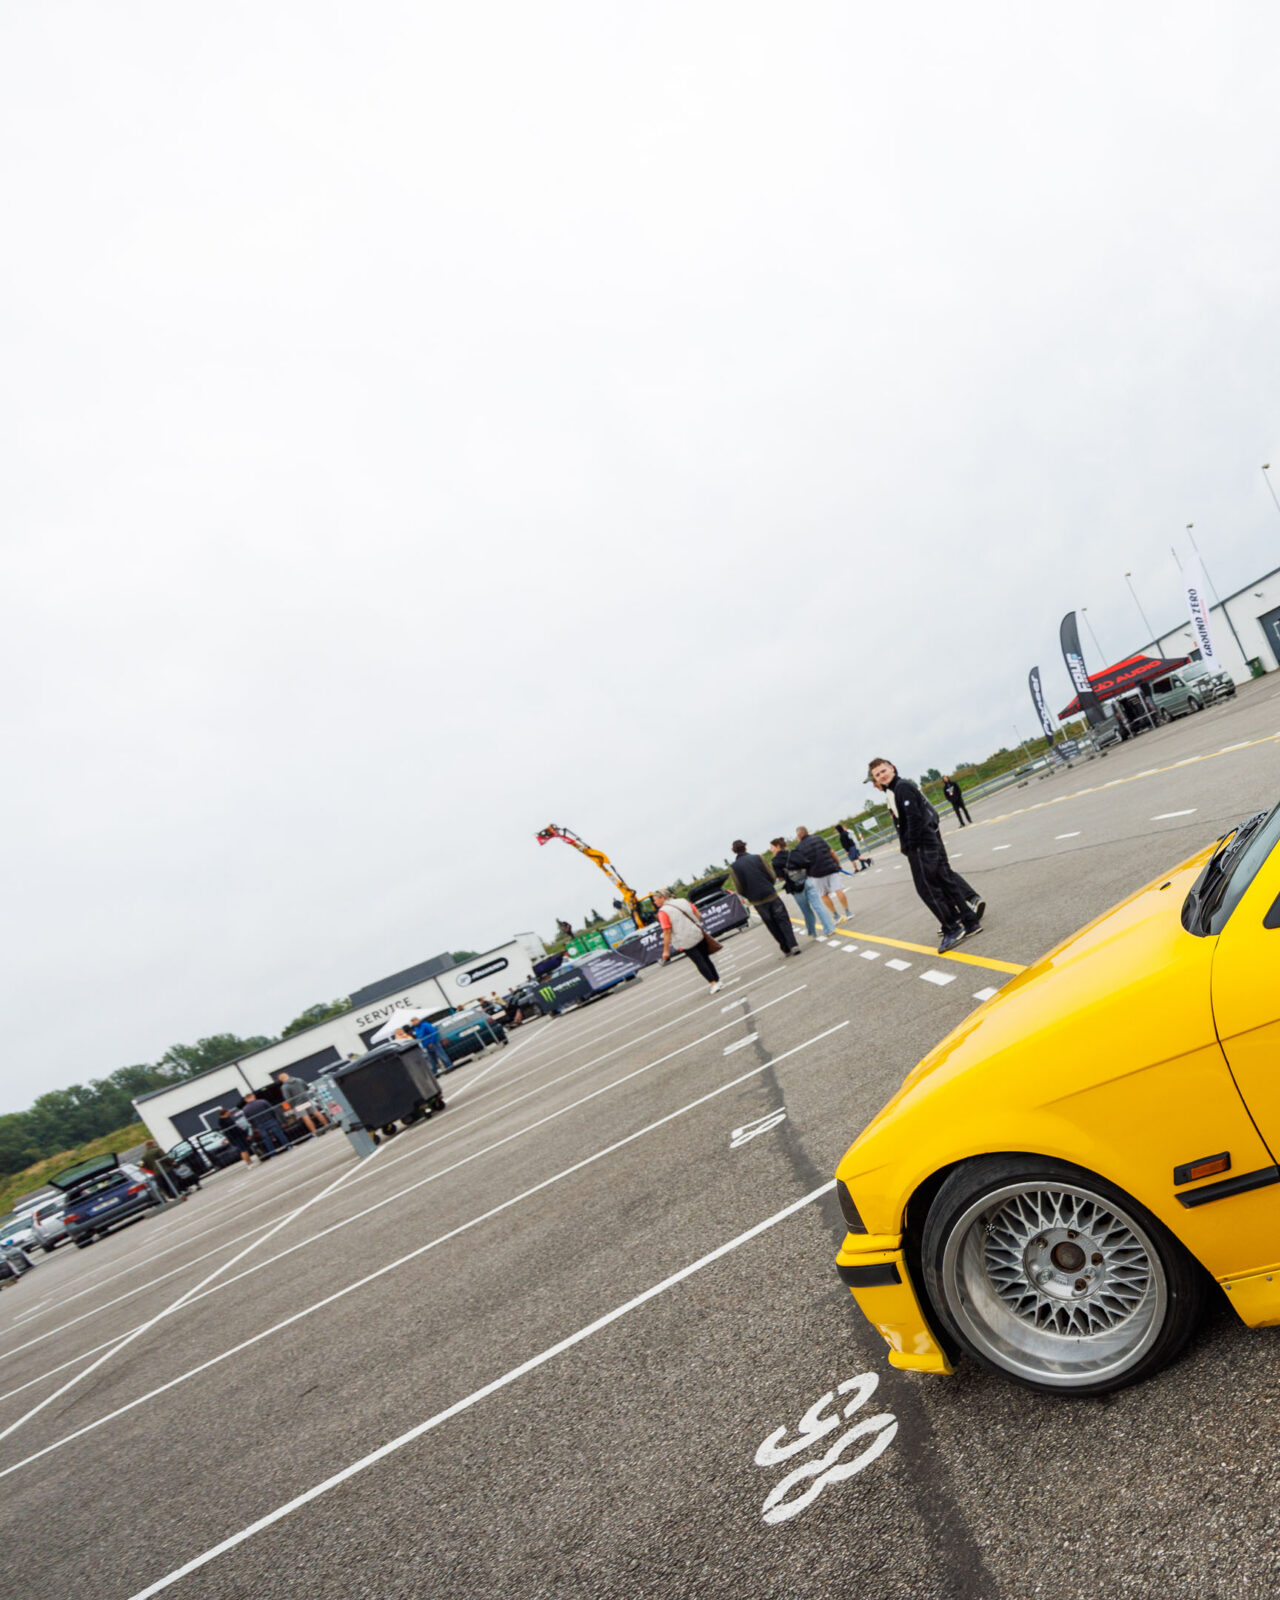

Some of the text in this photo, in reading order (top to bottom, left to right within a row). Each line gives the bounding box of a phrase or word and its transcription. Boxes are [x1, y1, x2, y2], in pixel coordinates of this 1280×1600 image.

[1188, 588, 1201, 614] ZERO
[1195, 616, 1213, 657] GROUND
[1116, 660, 1162, 684] AUDIO
[356, 997, 412, 1028] SERVICE
